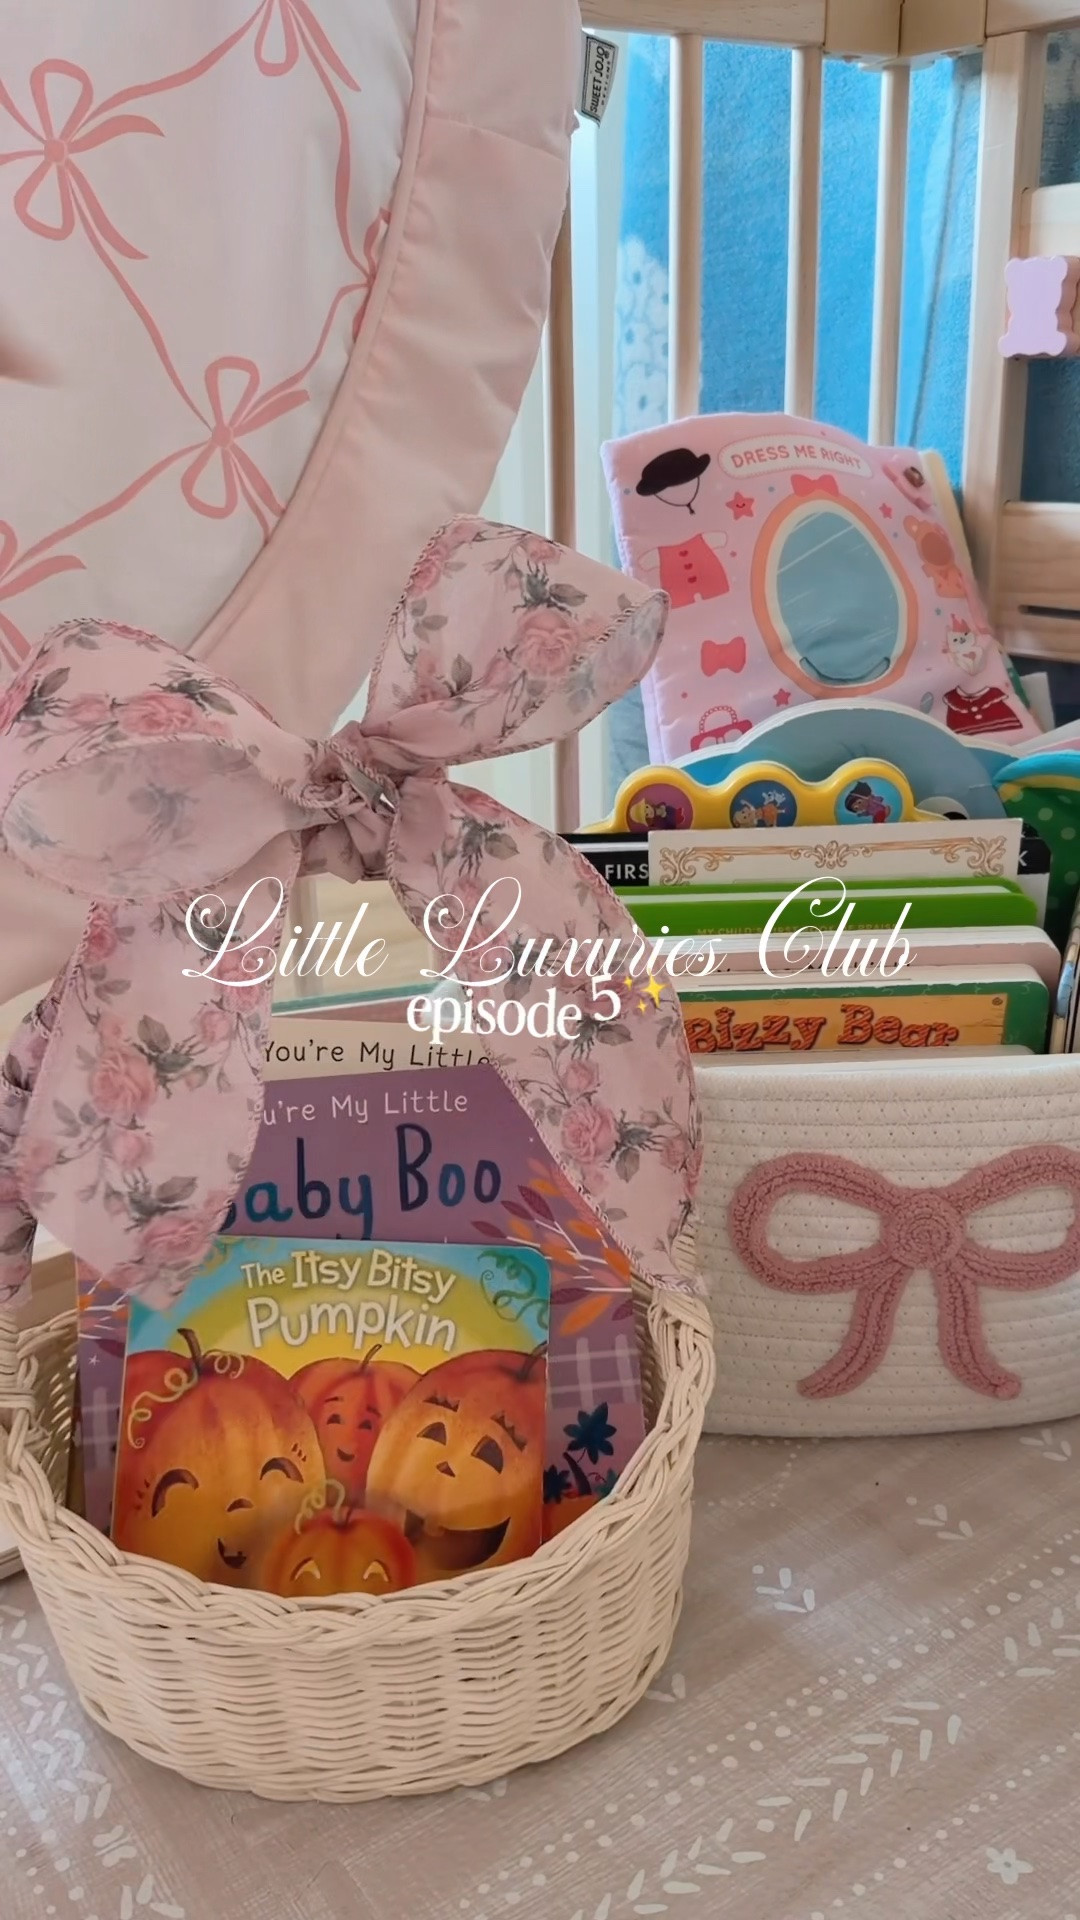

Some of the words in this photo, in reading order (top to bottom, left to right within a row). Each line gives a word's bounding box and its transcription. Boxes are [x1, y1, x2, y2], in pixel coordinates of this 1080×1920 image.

[595, 46, 606, 77] JOJO
[590, 76, 602, 113] SWEET
[730, 445, 790, 469] DRESS
[793, 445, 817, 459] ME
[821, 447, 862, 469] RIGHT
[604, 863, 649, 881] FIRS
[684, 1006, 827, 1053] Bizzy
[837, 1004, 960, 1048] Bear
[264, 1039, 344, 1063] You're
[360, 1041, 394, 1070] My
[263, 1100, 316, 1125] u're
[331, 1095, 368, 1123] My
[384, 1090, 468, 1115] Little
[220, 1137, 373, 1240] aby
[396, 1123, 501, 1212] Boo
[240, 1262, 287, 1289] The
[291, 1249, 362, 1290] Itsy
[367, 1248, 457, 1304] Bitsy
[247, 1294, 457, 1352] Pumpkin
